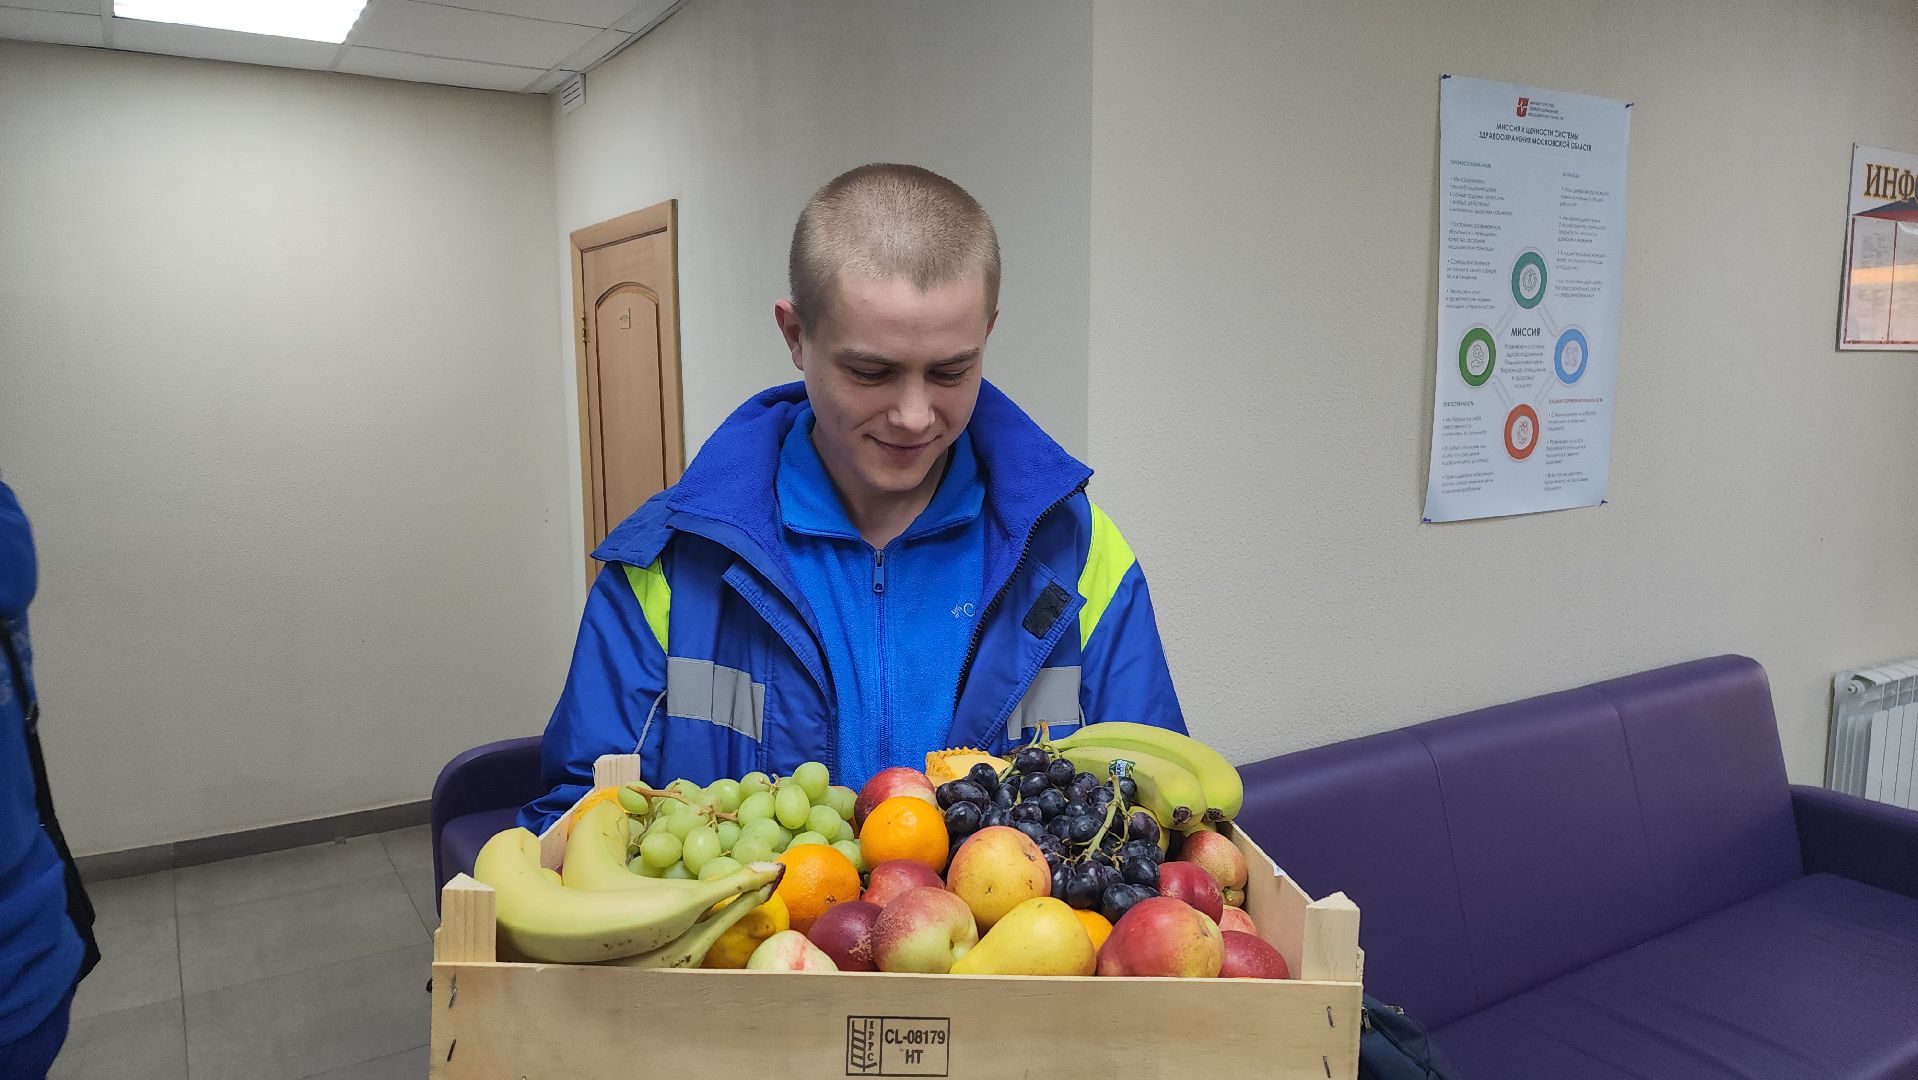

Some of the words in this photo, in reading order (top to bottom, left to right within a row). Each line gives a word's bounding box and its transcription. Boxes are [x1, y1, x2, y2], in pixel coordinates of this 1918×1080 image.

[1496, 122, 1520, 132] МИССИЯ
[1511, 327, 1541, 337] МИССИЯ
[884, 1028, 946, 1045] CL-08179
[905, 1048, 924, 1064] HT
